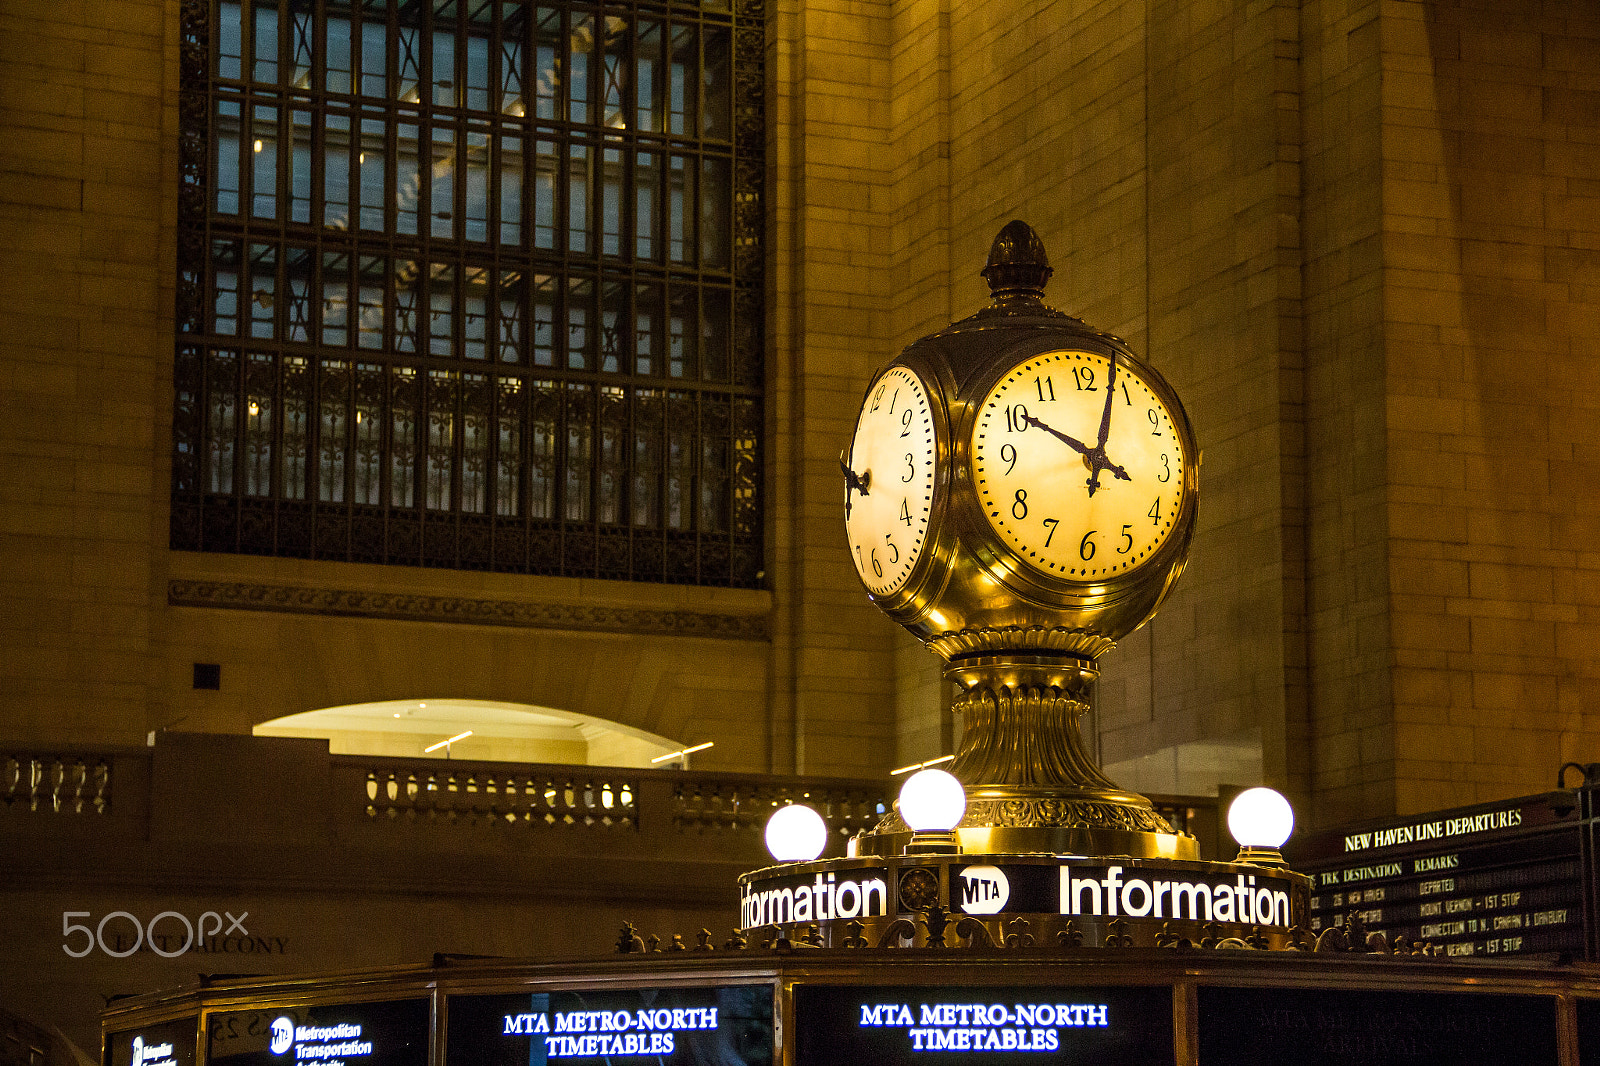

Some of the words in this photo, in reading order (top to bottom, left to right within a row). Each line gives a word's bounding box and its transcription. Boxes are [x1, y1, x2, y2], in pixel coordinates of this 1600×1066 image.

[1034, 376, 1057, 402] 11
[1072, 366, 1098, 392] 12
[1121, 380, 1133, 406] 1
[889, 387, 900, 415] 1
[900, 408, 913, 438] 2
[1004, 403, 1030, 433] 10
[1147, 408, 1162, 437] 2
[901, 453, 914, 483] 3
[1000, 443, 1017, 476] 9
[1157, 453, 1171, 483] 3
[899, 497, 913, 527] 4
[1011, 488, 1028, 520] 8
[1147, 496, 1162, 526] 4
[1042, 518, 1060, 548] 7
[1079, 530, 1098, 562] 6
[1116, 524, 1133, 554] 5
[871, 548, 883, 578] 6
[885, 533, 899, 564] 5
[1344, 832, 1373, 852] NEW
[1374, 825, 1414, 848] HAVEN
[1415, 821, 1444, 842] LINE
[1445, 808, 1522, 837] DEPARTURES
[1321, 871, 1340, 886] TRK
[1343, 861, 1403, 883] DESTINATION
[1414, 854, 1460, 874] REMARKS
[1059, 864, 1290, 927] Information
[1419, 878, 1455, 896] DEPARTED
[1501, 891, 1521, 908] STOP
[1420, 920, 1465, 939] CONNECTION
[1467, 919, 1478, 933] TO
[114, 934, 173, 954] ET
[1503, 937, 1523, 952] STOP
[503, 1012, 550, 1034] MTA
[554, 1007, 718, 1032] METRO-NORTH
[860, 1004, 914, 1026] MTA
[920, 1004, 1108, 1026] METRO-NORTH
[295, 1023, 361, 1042] Metropolitan
[544, 1032, 675, 1057] TIMETABLES
[909, 1028, 1059, 1051] TIMETABLES
[295, 1040, 372, 1060] Transportation
